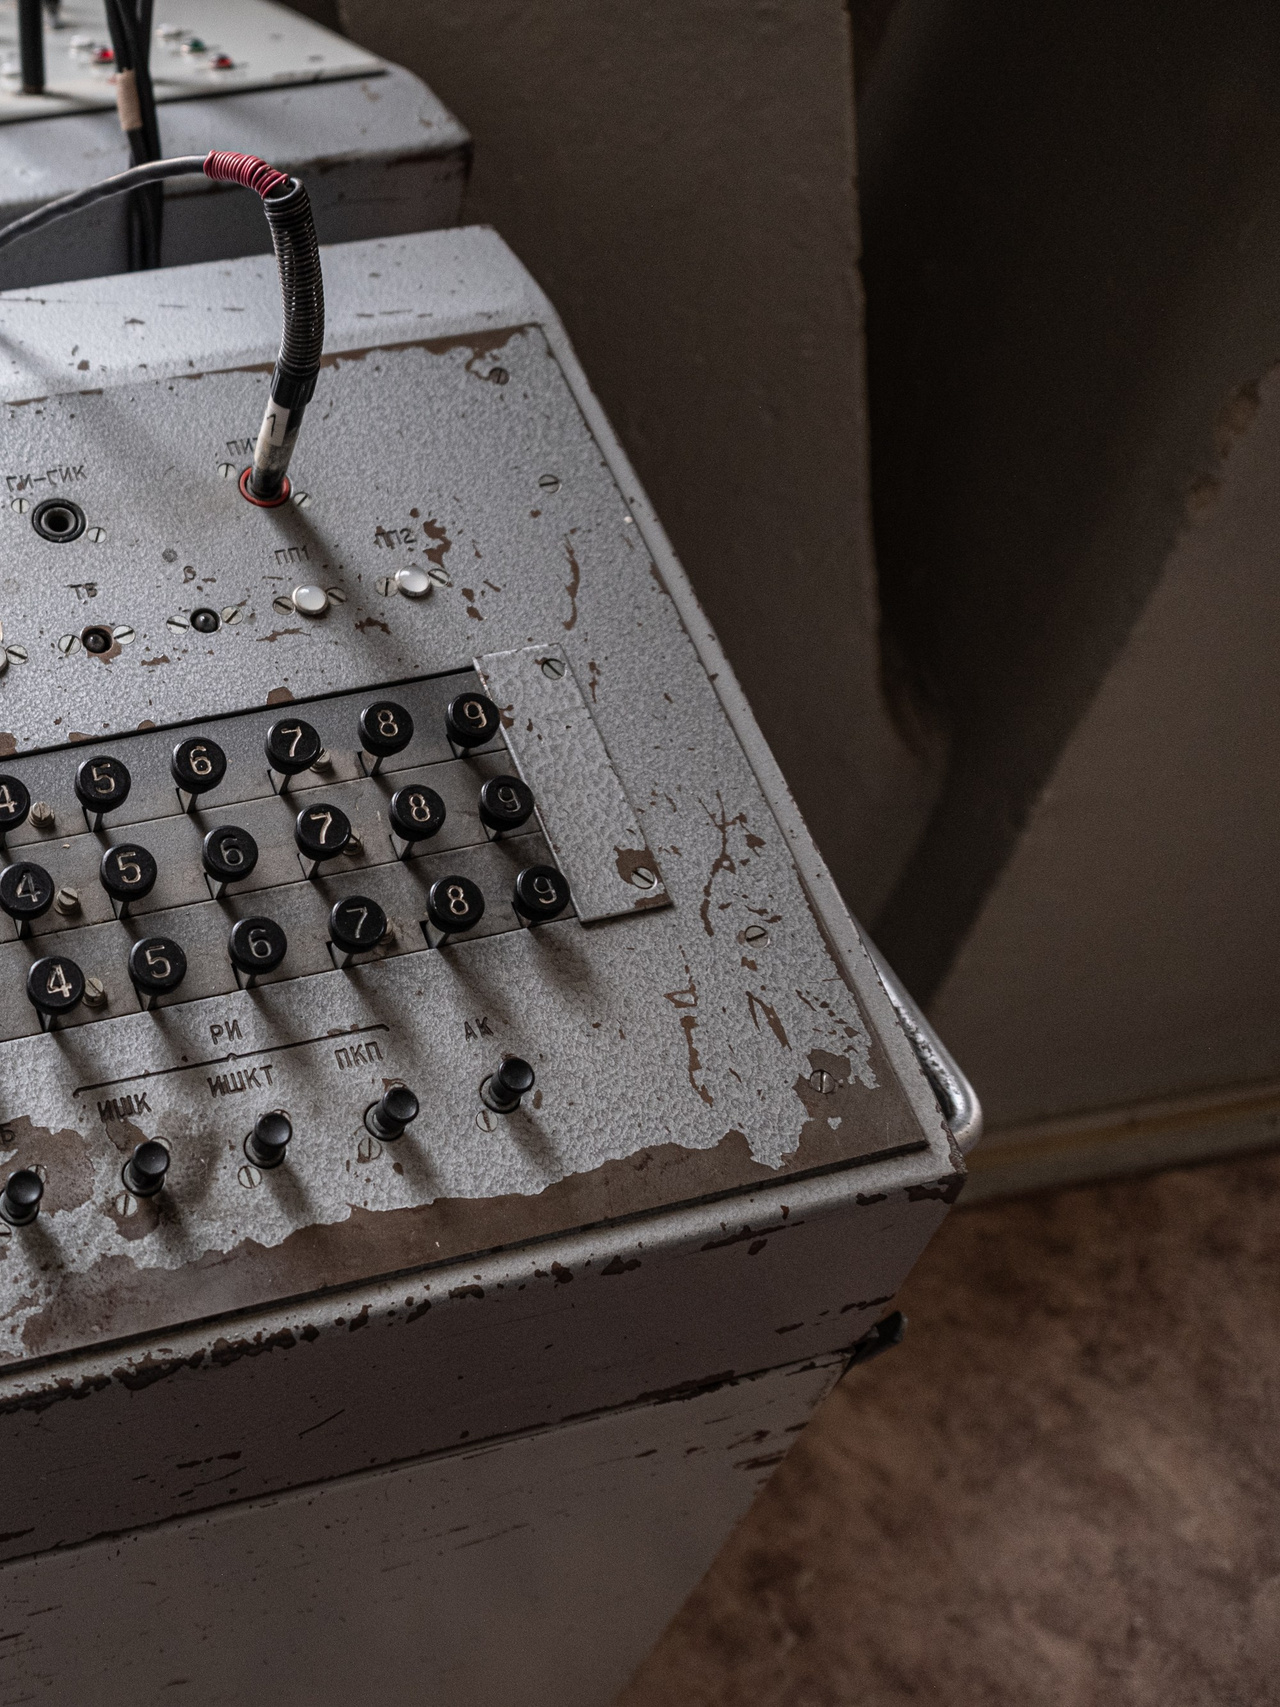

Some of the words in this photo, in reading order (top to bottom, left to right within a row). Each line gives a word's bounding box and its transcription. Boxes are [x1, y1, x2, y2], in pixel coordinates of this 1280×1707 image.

[226, 437, 258, 457] ПИ
[274, 545, 309, 565] ПП1
[377, 709, 398, 738] 8
[463, 700, 487, 729] 9
[281, 725, 303, 758] 7
[190, 745, 212, 775] 6
[92, 763, 115, 794] 5
[408, 793, 431, 823] 8
[498, 785, 521, 813] 9
[310, 812, 333, 845] 7
[221, 836, 244, 866] 6
[116, 851, 141, 884] 5
[16, 870, 39, 903] 4
[446, 884, 470, 916] 8
[533, 876, 557, 904] 9
[346, 906, 369, 939] 7
[248, 928, 272, 959] 6
[145, 945, 171, 979] 5
[47, 963, 72, 998] 4
[209, 1019, 243, 1045] РИ
[463, 1017, 494, 1042] АК
[334, 1041, 384, 1070] ПКП
[207, 1064, 274, 1099] ИШКТ
[96, 1092, 152, 1122] ИШК
